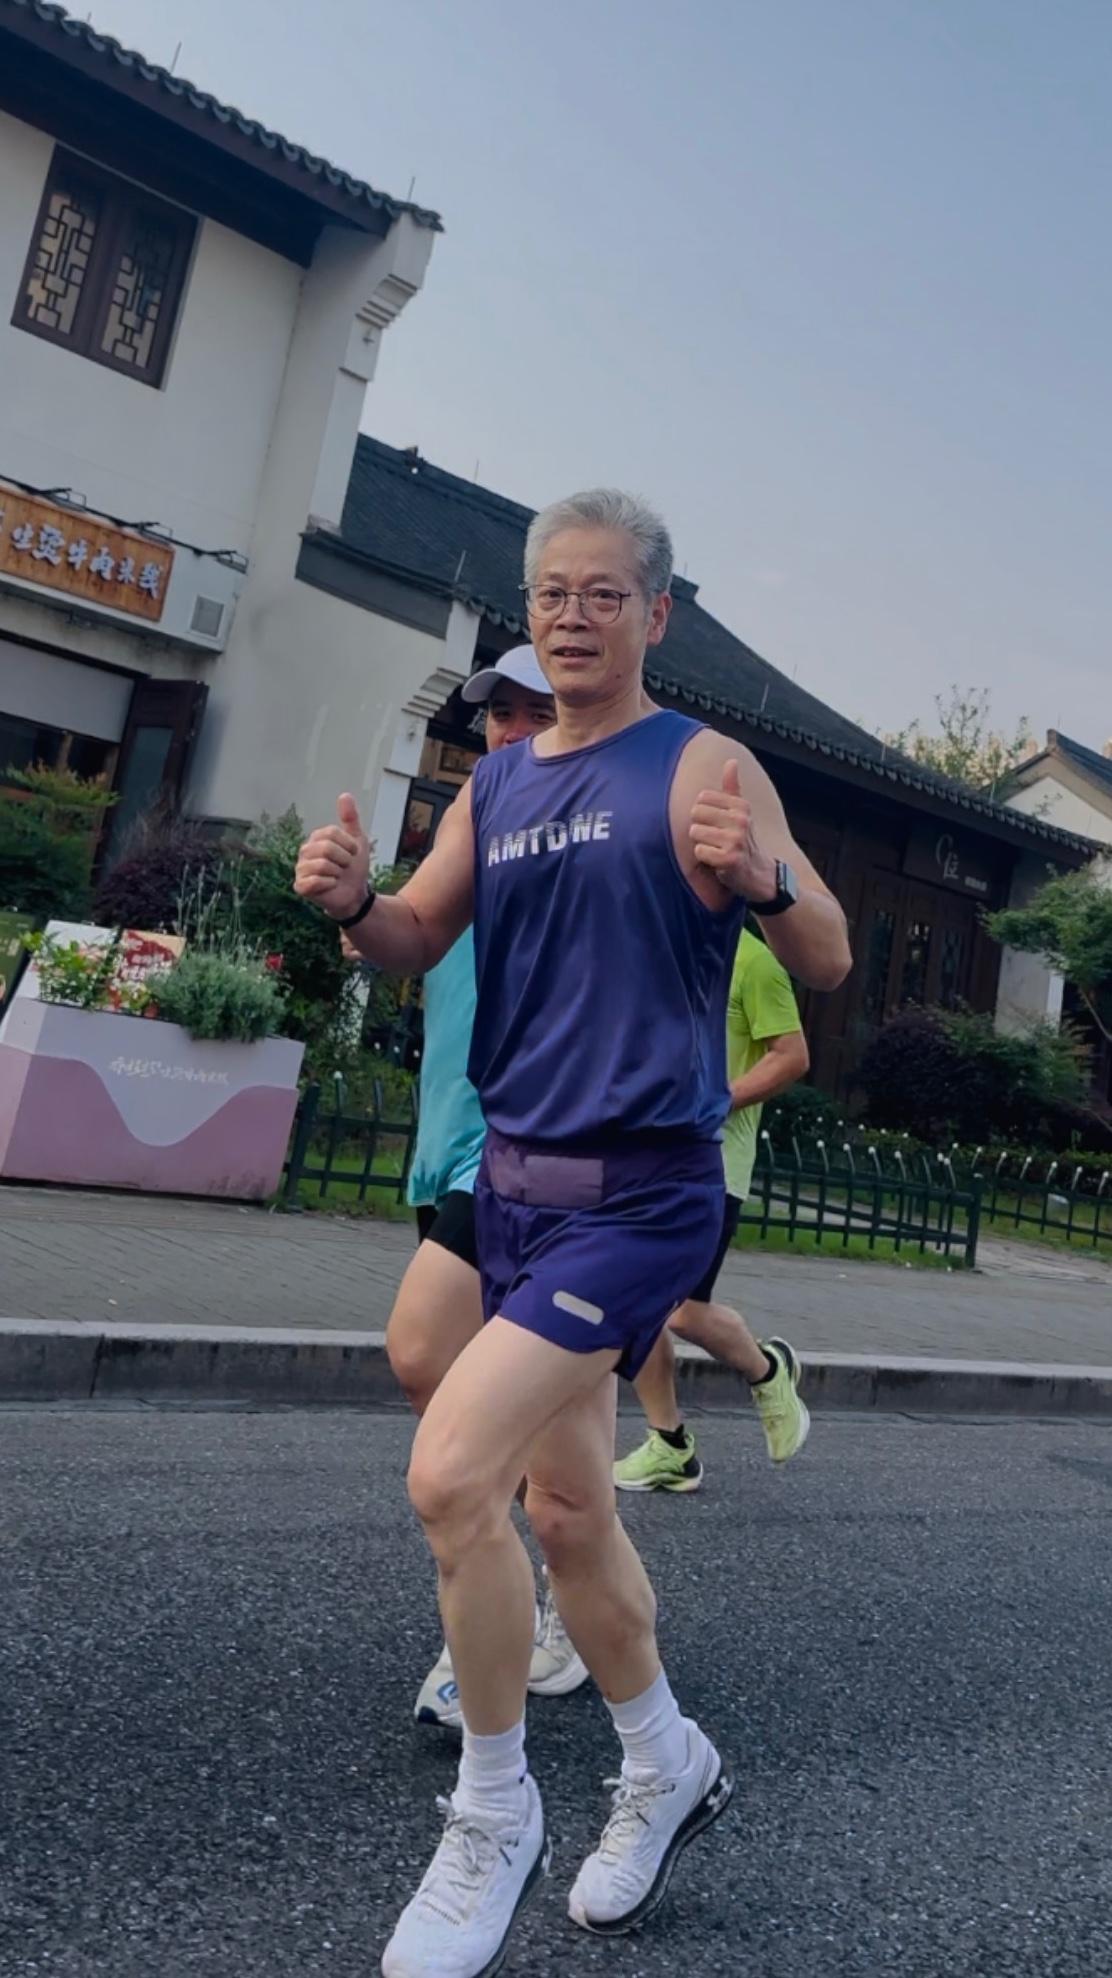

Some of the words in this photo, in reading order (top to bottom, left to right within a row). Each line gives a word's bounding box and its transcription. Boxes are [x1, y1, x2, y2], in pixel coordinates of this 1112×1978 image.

[0, 511, 164, 600] 生烫牛肉米线
